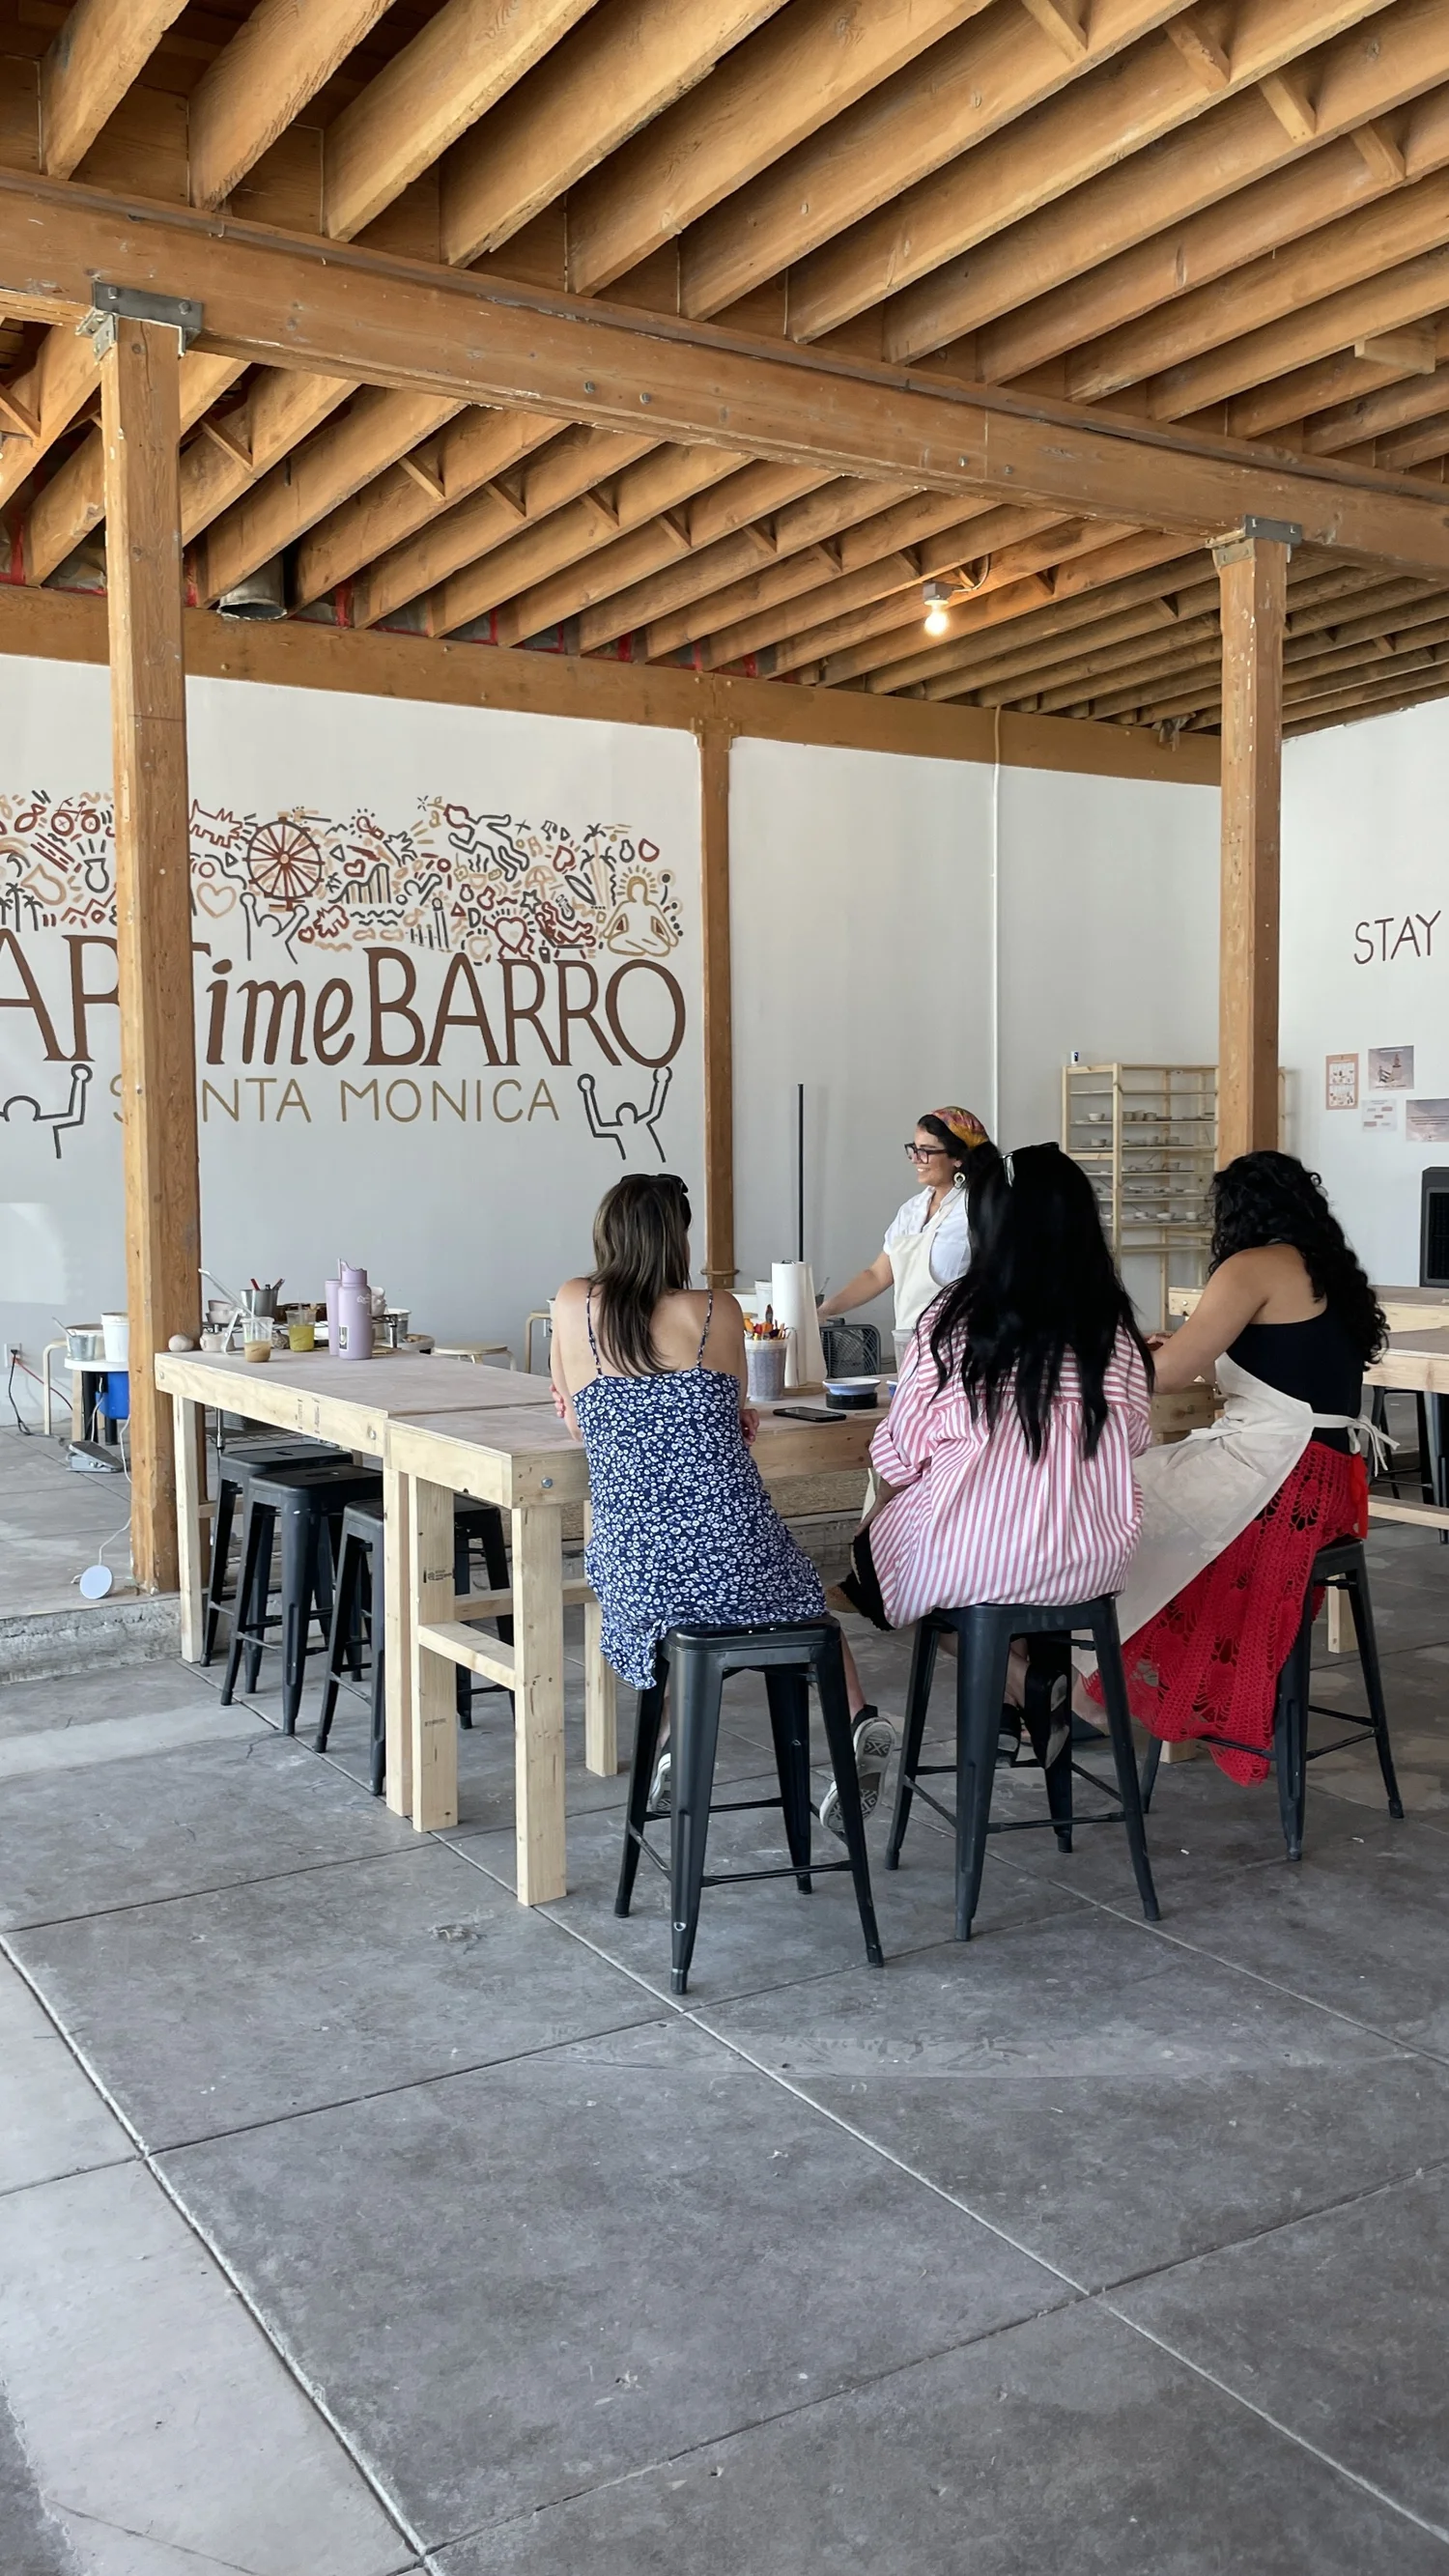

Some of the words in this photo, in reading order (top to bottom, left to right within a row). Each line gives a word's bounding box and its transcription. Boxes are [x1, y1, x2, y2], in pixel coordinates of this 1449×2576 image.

[1353, 910, 1441, 964] STAY
[109, 1073, 312, 1123] NTA
[340, 1078, 559, 1122] MONICA
